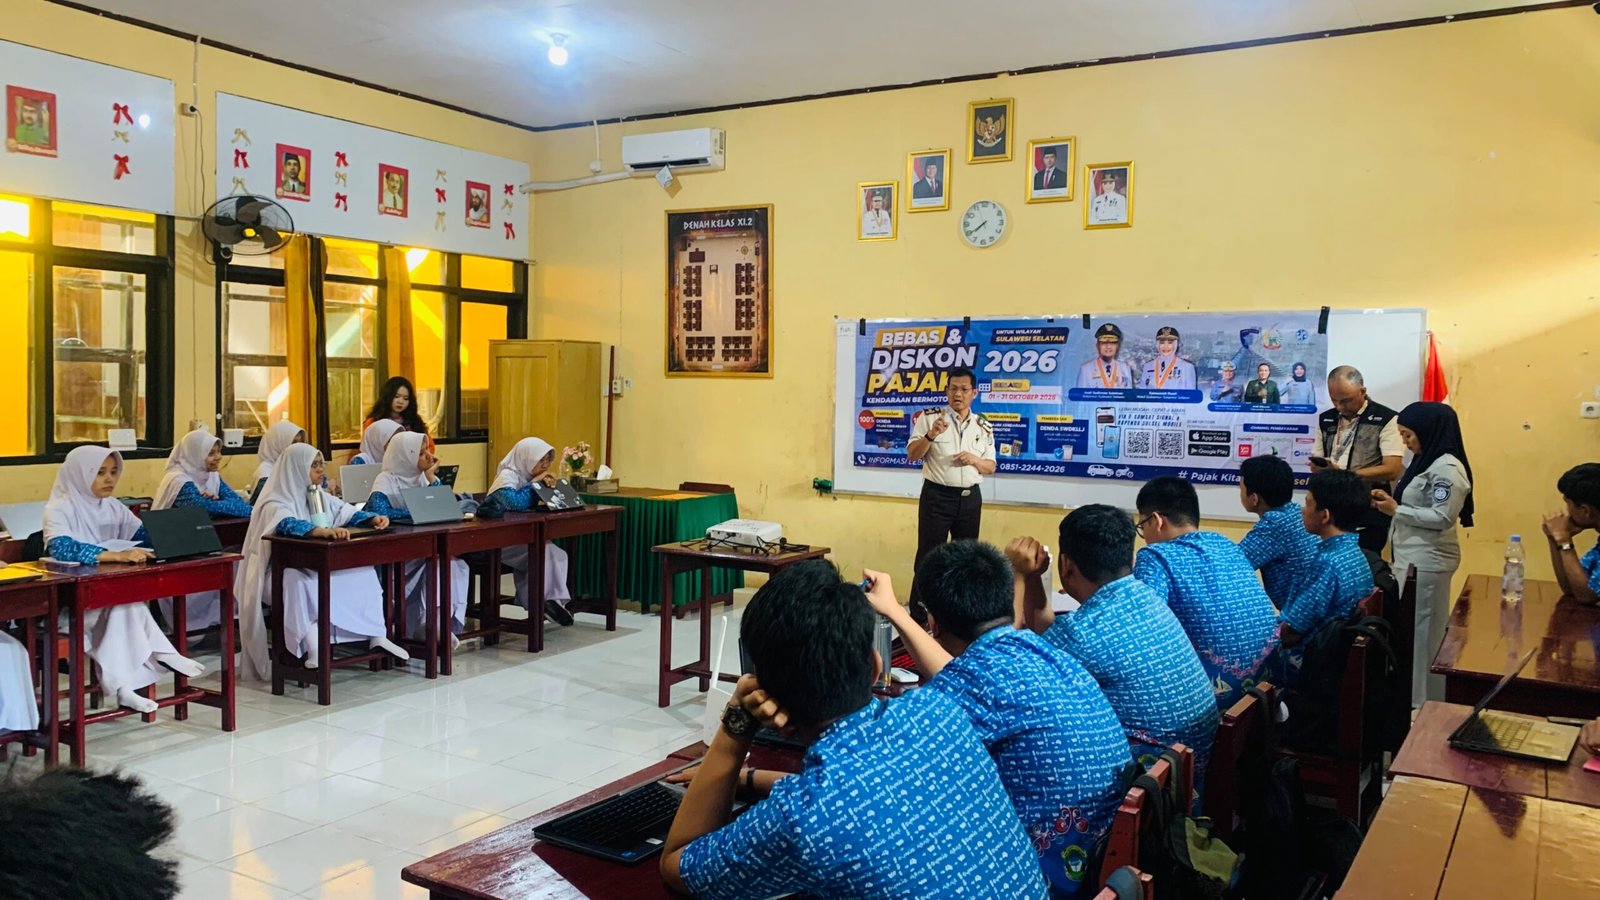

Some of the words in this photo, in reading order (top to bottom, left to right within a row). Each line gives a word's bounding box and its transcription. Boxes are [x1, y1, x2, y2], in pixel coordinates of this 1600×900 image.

[684, 219, 710, 230] DENAH
[710, 218, 735, 229] KELAS
[737, 218, 753, 227] XI.2
[882, 330, 940, 346] BEBAS
[947, 328, 962, 345] &
[872, 346, 977, 370] DISKON
[984, 350, 1059, 373] 2026
[1000, 463, 1066, 473] 0851-2244-2026
[1191, 472, 1218, 482] Pajak
[1221, 474, 1241, 482] Kita
[1294, 478, 1309, 486] sel
